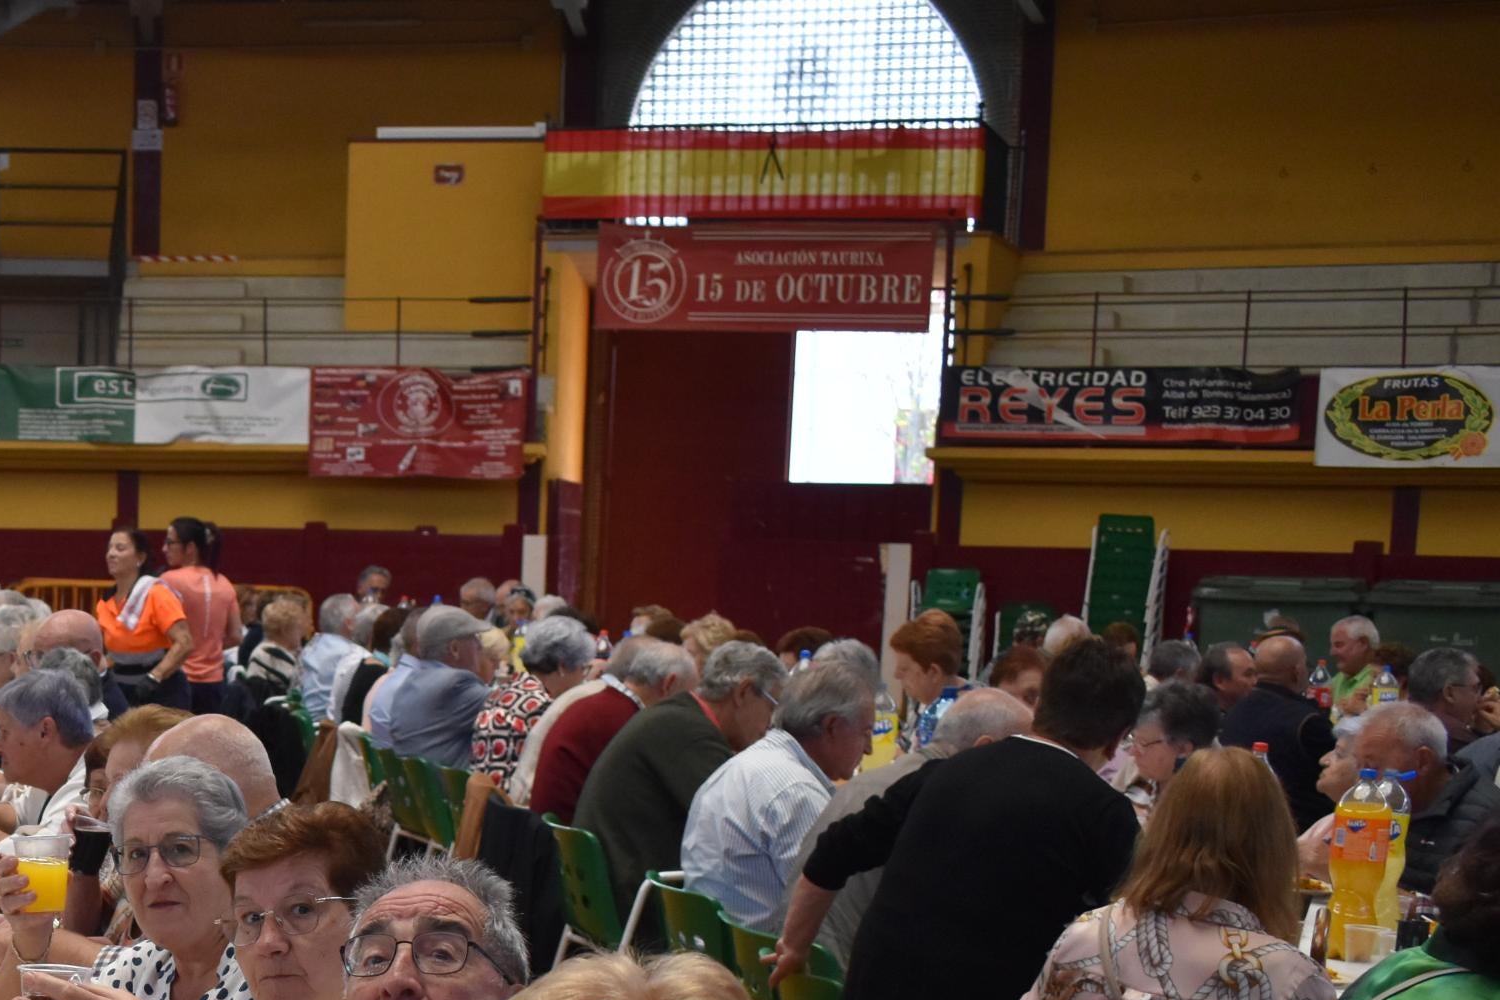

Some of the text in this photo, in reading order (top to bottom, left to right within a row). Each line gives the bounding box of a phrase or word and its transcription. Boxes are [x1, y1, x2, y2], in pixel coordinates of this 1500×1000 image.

[734, 250, 884, 267] ASOCIACIÓN TAURINA
[695, 273, 922, 304] 15 DE OCTUBRE
[1383, 377, 1440, 389] FRUTAS
[958, 386, 1147, 426] REYES
[1191, 404, 1221, 419] 923
[1243, 407, 1265, 421] 04
[1268, 406, 1291, 420] 30
[1357, 393, 1465, 421] La Perla
